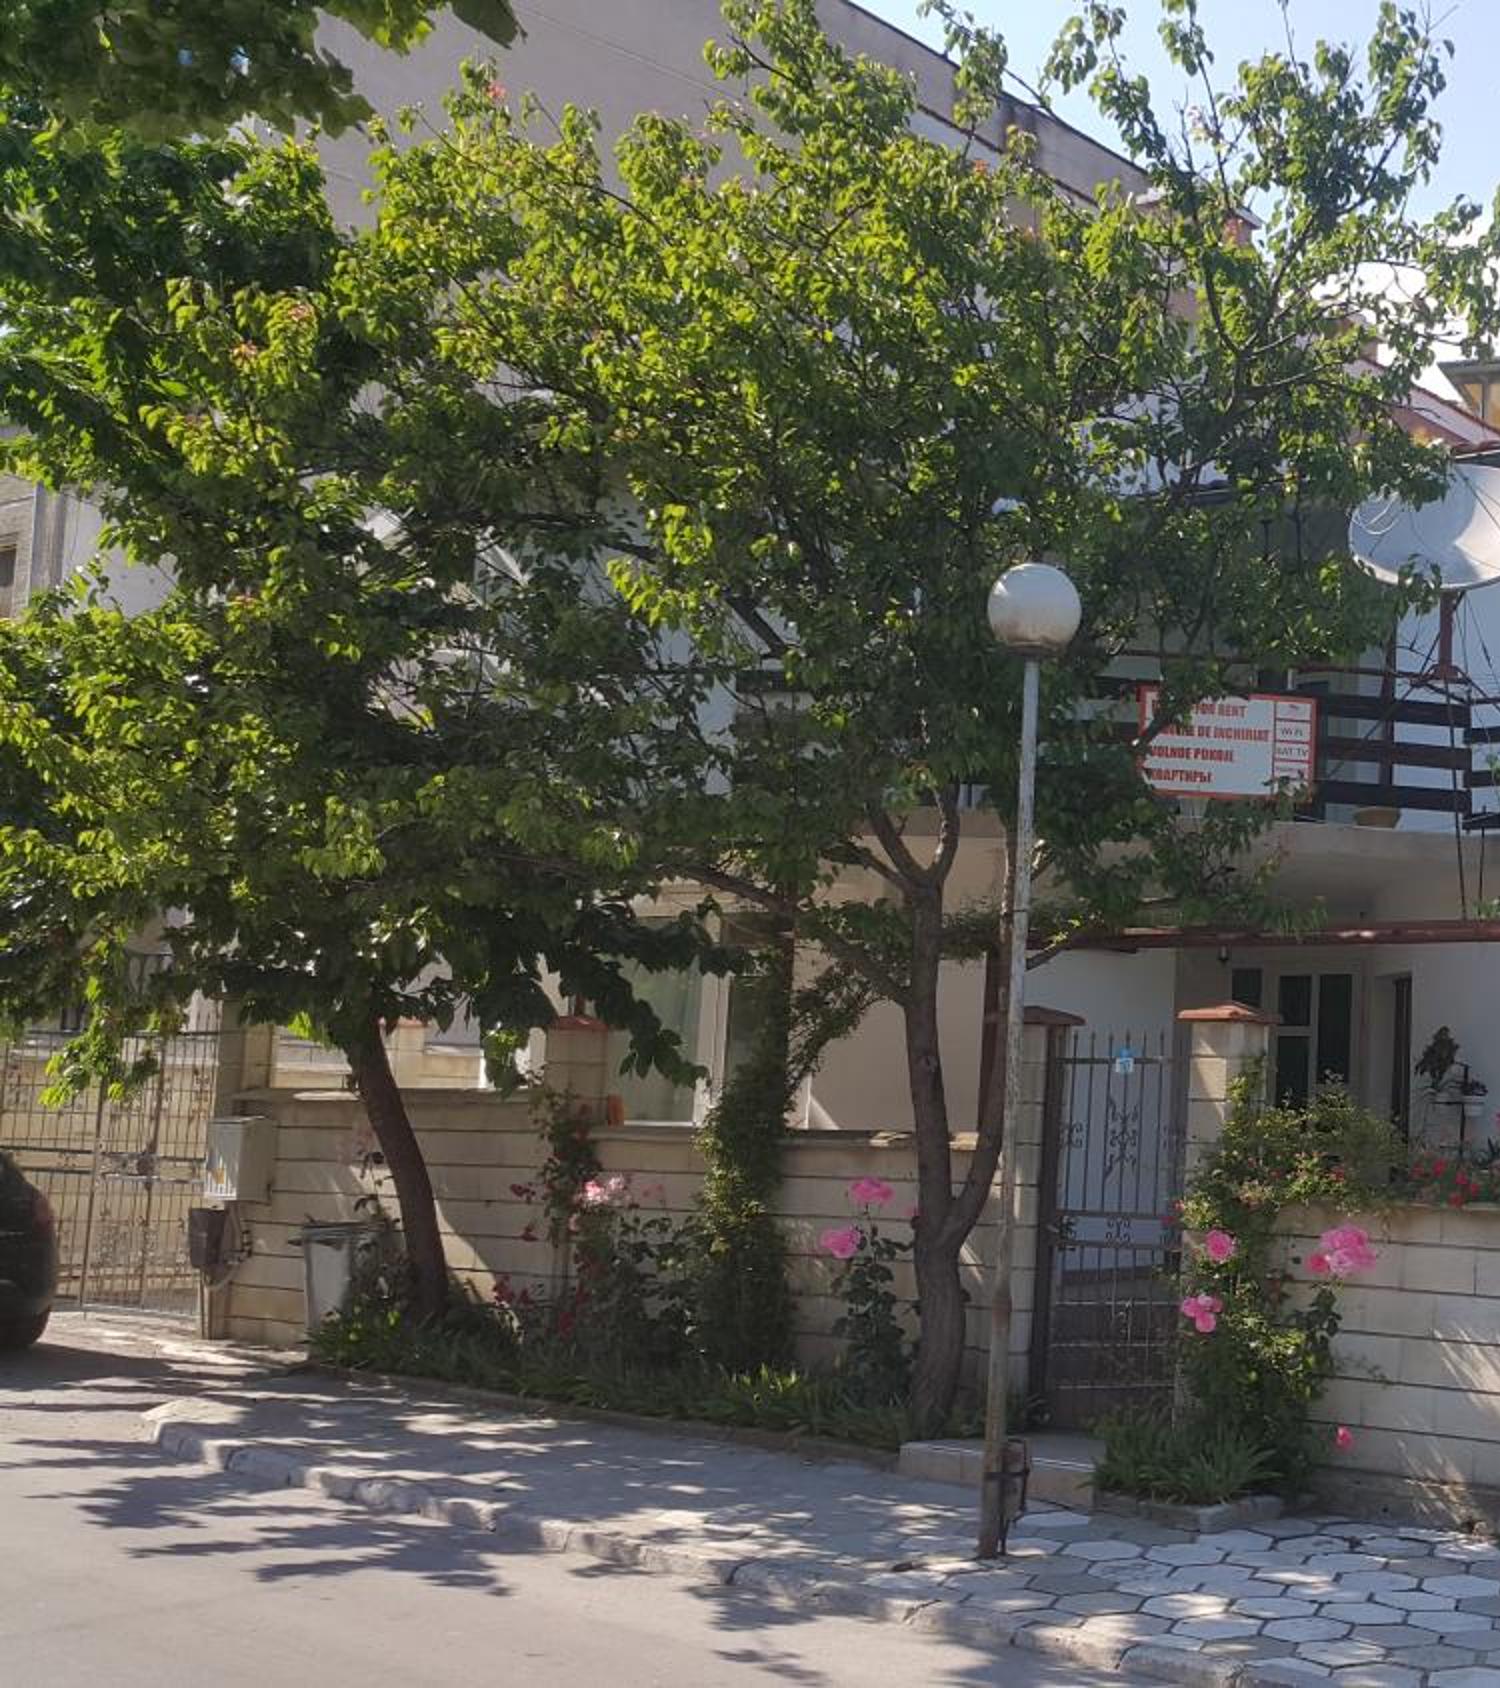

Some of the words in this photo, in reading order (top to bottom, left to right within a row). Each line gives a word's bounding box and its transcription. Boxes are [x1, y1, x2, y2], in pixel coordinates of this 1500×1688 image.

[1217, 704, 1247, 718] RENT
[1197, 726, 1212, 738] DE
[1213, 727, 1269, 741] INCHIRIAT
